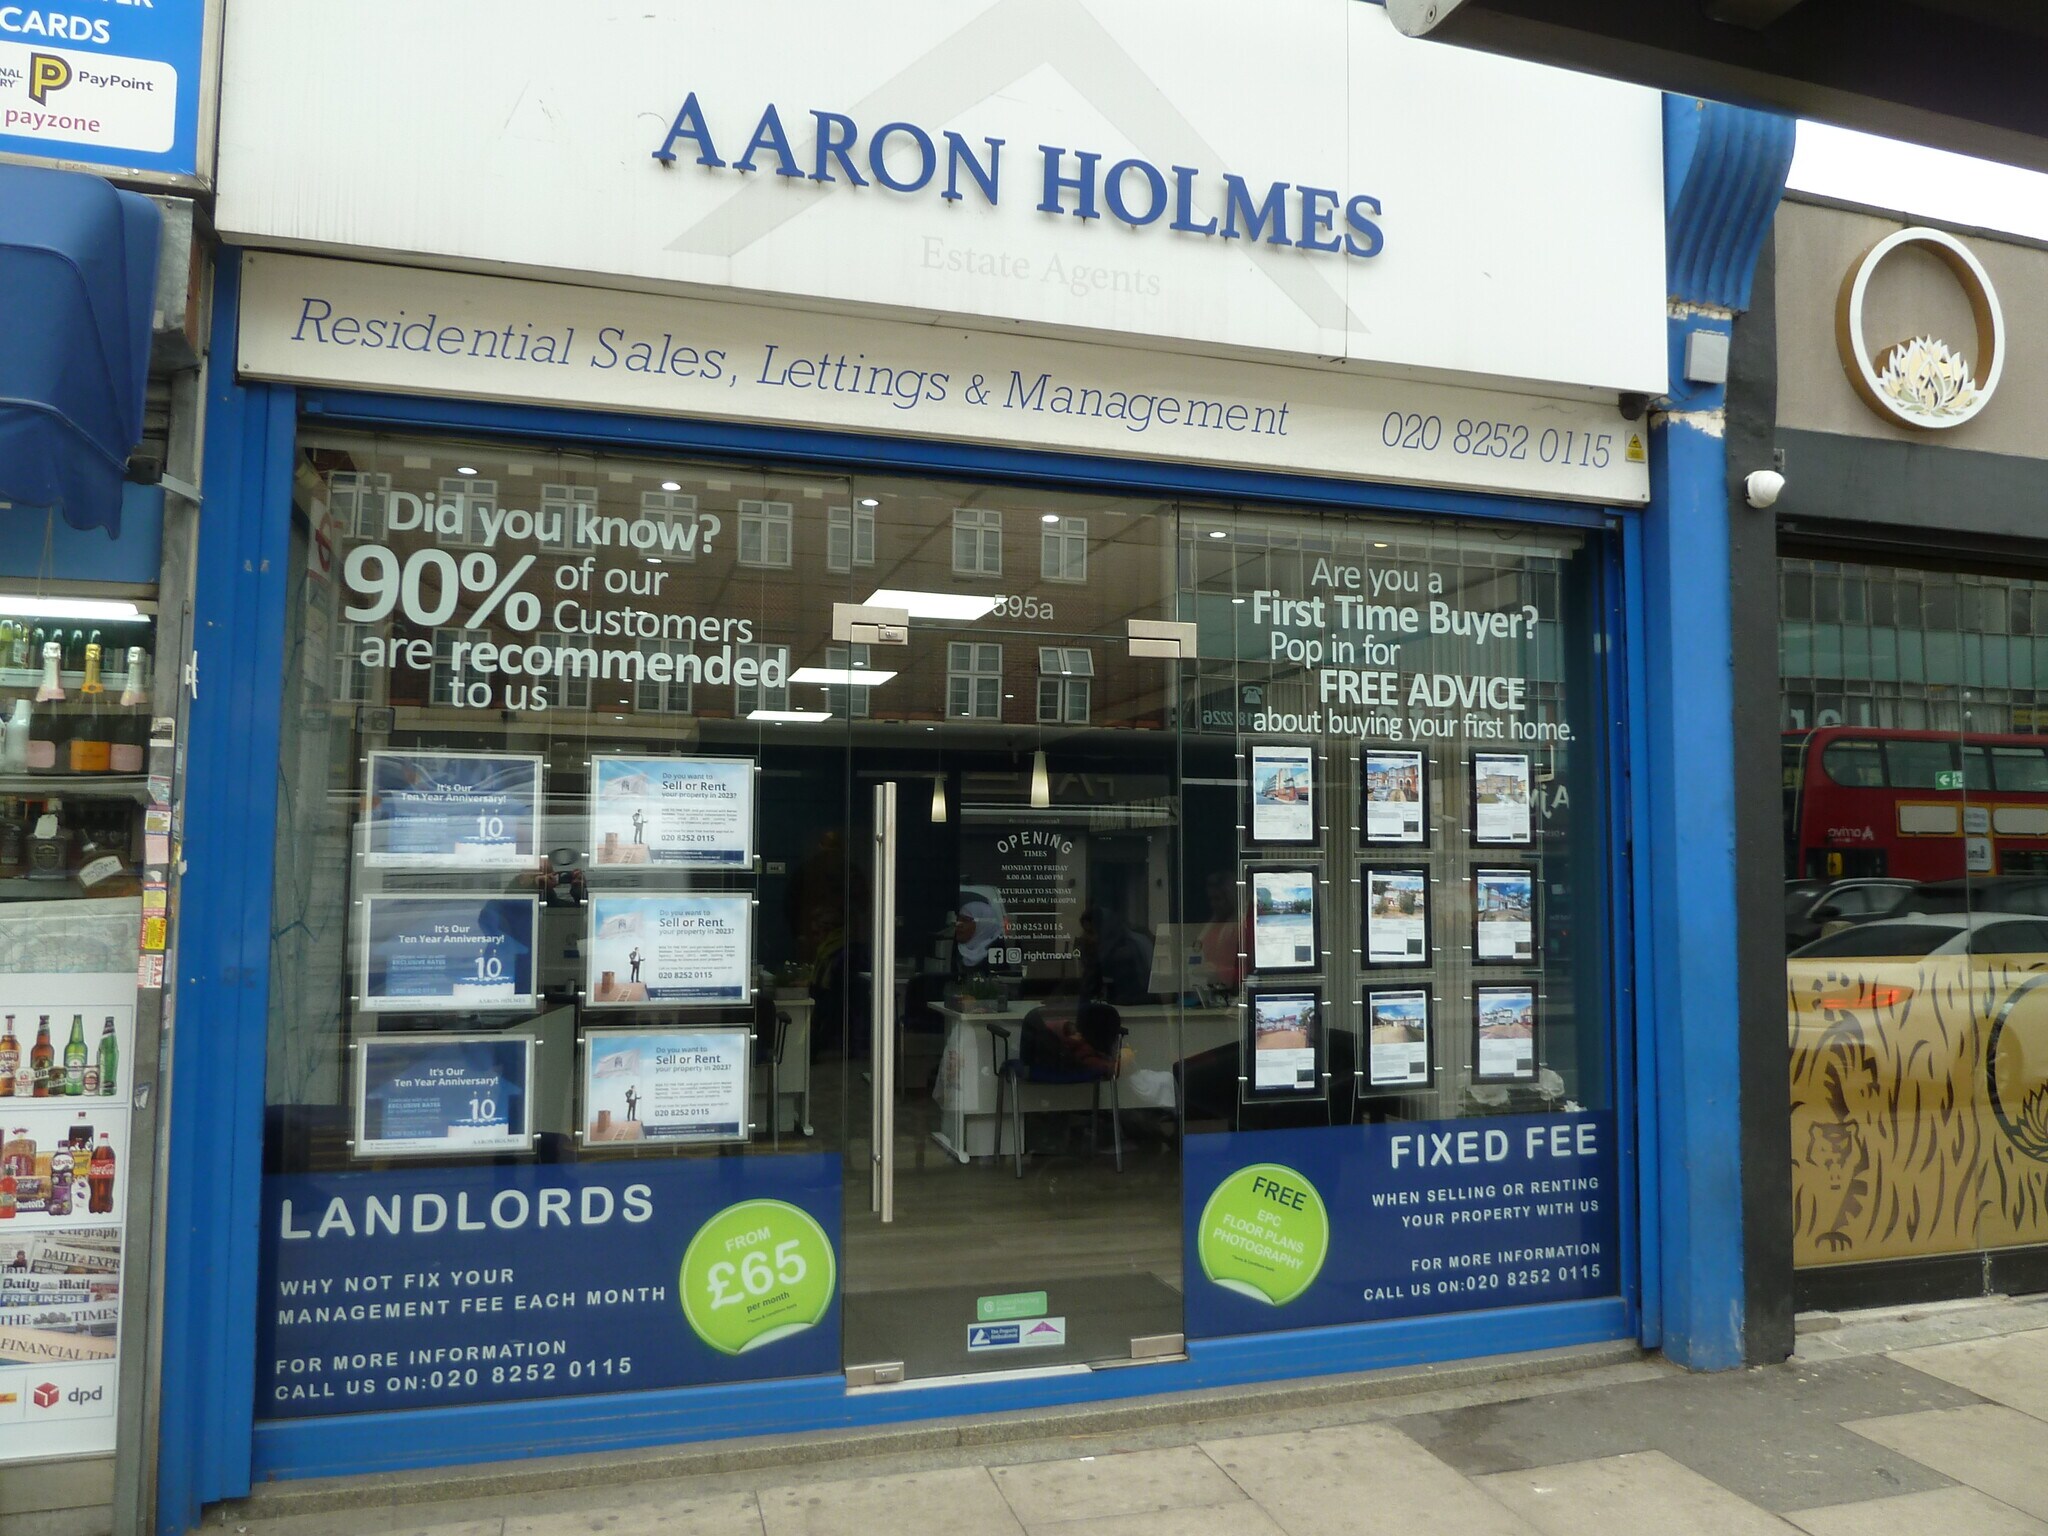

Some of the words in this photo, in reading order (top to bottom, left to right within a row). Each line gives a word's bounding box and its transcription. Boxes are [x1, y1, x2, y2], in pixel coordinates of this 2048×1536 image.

[0, 6, 110, 44] CARDS
[79, 71, 154, 91] PayPoint
[5, 109, 101, 132] payzone
[653, 92, 1005, 207] AARON
[1036, 144, 1386, 259] HOLMES
[920, 236, 1031, 282] Estate
[1042, 251, 1162, 297] Agents
[291, 297, 574, 365] Residential
[590, 327, 738, 388] Sales,
[756, 344, 951, 410] Lettings
[964, 374, 991, 405] &
[1003, 370, 1289, 437] Management
[1382, 411, 1442, 451] 020
[1453, 419, 1529, 460] 8252
[1539, 428, 1612, 468] 0115
[387, 491, 464, 535] Did
[478, 506, 561, 547] you
[577, 503, 722, 554] know?
[343, 544, 542, 632] 90%
[555, 556, 597, 592] of
[604, 566, 669, 596] our
[1311, 557, 1361, 588] Are
[1370, 567, 1418, 597] you
[1428, 572, 1443, 594] a
[992, 594, 1054, 620] 595a
[1253, 590, 1325, 629] First
[1334, 595, 1418, 633] Time
[1430, 601, 1539, 645] Buyer?
[553, 600, 753, 644] Customers
[360, 636, 433, 671] are
[451, 640, 788, 689] recommended
[1271, 631, 1323, 668] Pop
[1331, 634, 1355, 664] in
[1363, 633, 1400, 666] for
[448, 677, 492, 709] to
[504, 684, 548, 711] us
[1320, 669, 1398, 706] FREE
[1407, 672, 1526, 711] ADVICE
[1253, 705, 1322, 734] about
[1328, 708, 1403, 742] buying
[1408, 714, 1459, 742] your
[1463, 714, 1504, 738] first
[1510, 717, 1576, 742] home.
[662, 781, 682, 791] Sell
[685, 783, 697, 791] or
[700, 782, 727, 792] Rent
[476, 816, 503, 838] 10
[997, 831, 1073, 854] OPENING
[451, 925, 470, 933] Our
[660, 918, 680, 927] Sell
[698, 918, 724, 927] Rent
[1023, 923, 1043, 931] 8252
[399, 934, 417, 943] Ten
[420, 934, 441, 943] Year
[443, 934, 505, 945] Anniversary!
[474, 957, 502, 978] 10
[1023, 950, 1072, 961] rightmove
[446, 1067, 465, 1076] Our
[656, 1055, 676, 1065] Sell
[694, 1055, 721, 1064] Rent
[394, 1078, 412, 1087] Ten
[414, 1078, 436, 1087] Year
[438, 1076, 499, 1087] Anniversary!
[468, 1098, 496, 1120] 10
[691, 1108, 709, 1116] 0115
[1391, 1129, 1509, 1169] FIXED
[1526, 1123, 1598, 1160] FEE
[1252, 1176, 1307, 1211] FREE
[1372, 1192, 1420, 1207] WHEN
[1427, 1186, 1496, 1202] SELLING
[1502, 1183, 1524, 1196] OR
[1530, 1177, 1599, 1194] RENTING
[280, 1183, 654, 1240] LANDLORDS
[1257, 1209, 1282, 1228] EPC
[1401, 1213, 1444, 1228] YOUR
[1451, 1205, 1531, 1224] PROPERTY
[1536, 1203, 1574, 1217] WITH
[1580, 1200, 1599, 1212] US
[725, 1226, 771, 1252] FROM
[1222, 1214, 1263, 1238] FLOOR
[1264, 1230, 1305, 1253] PLANS
[43, 1248, 79, 1264] DAILY
[1213, 1228, 1305, 1270] PHOTOGRAPHY
[1411, 1259, 1442, 1272] FOR
[1449, 1253, 1491, 1268] MORE
[1498, 1243, 1600, 1263] INFORMATION
[2, 1278, 40, 1292] Daily
[58, 1278, 91, 1291] Mail
[280, 1278, 333, 1296] WHY
[345, 1274, 393, 1292] NOT
[404, 1272, 440, 1289] FIX
[451, 1268, 515, 1286] YOUR
[707, 1239, 807, 1310] £65
[1364, 1285, 1404, 1301] CALL
[1411, 1283, 1431, 1297] US
[1507, 1268, 1550, 1286] 8252
[1558, 1264, 1600, 1281] 0115
[2, 1294, 37, 1304] FREE
[39, 1293, 85, 1303] INSIDE
[278, 1300, 450, 1325] MANAGEMENT
[461, 1296, 503, 1314] FEE
[515, 1292, 576, 1310] EACH
[587, 1286, 666, 1305] MONTH
[746, 1302, 761, 1314] per
[762, 1291, 790, 1307] month
[0, 1314, 32, 1326] THE
[71, 1308, 118, 1321] TIMES
[1, 1338, 83, 1360] FINANCIAL
[276, 1356, 322, 1374] FOR
[333, 1351, 398, 1371] MORE
[409, 1340, 567, 1365] INFORMATION
[275, 1382, 334, 1400] CALL
[346, 1378, 376, 1395] US
[492, 1362, 556, 1384] 8252
[569, 1357, 633, 1378] 0115
[68, 1386, 103, 1405] dpd
